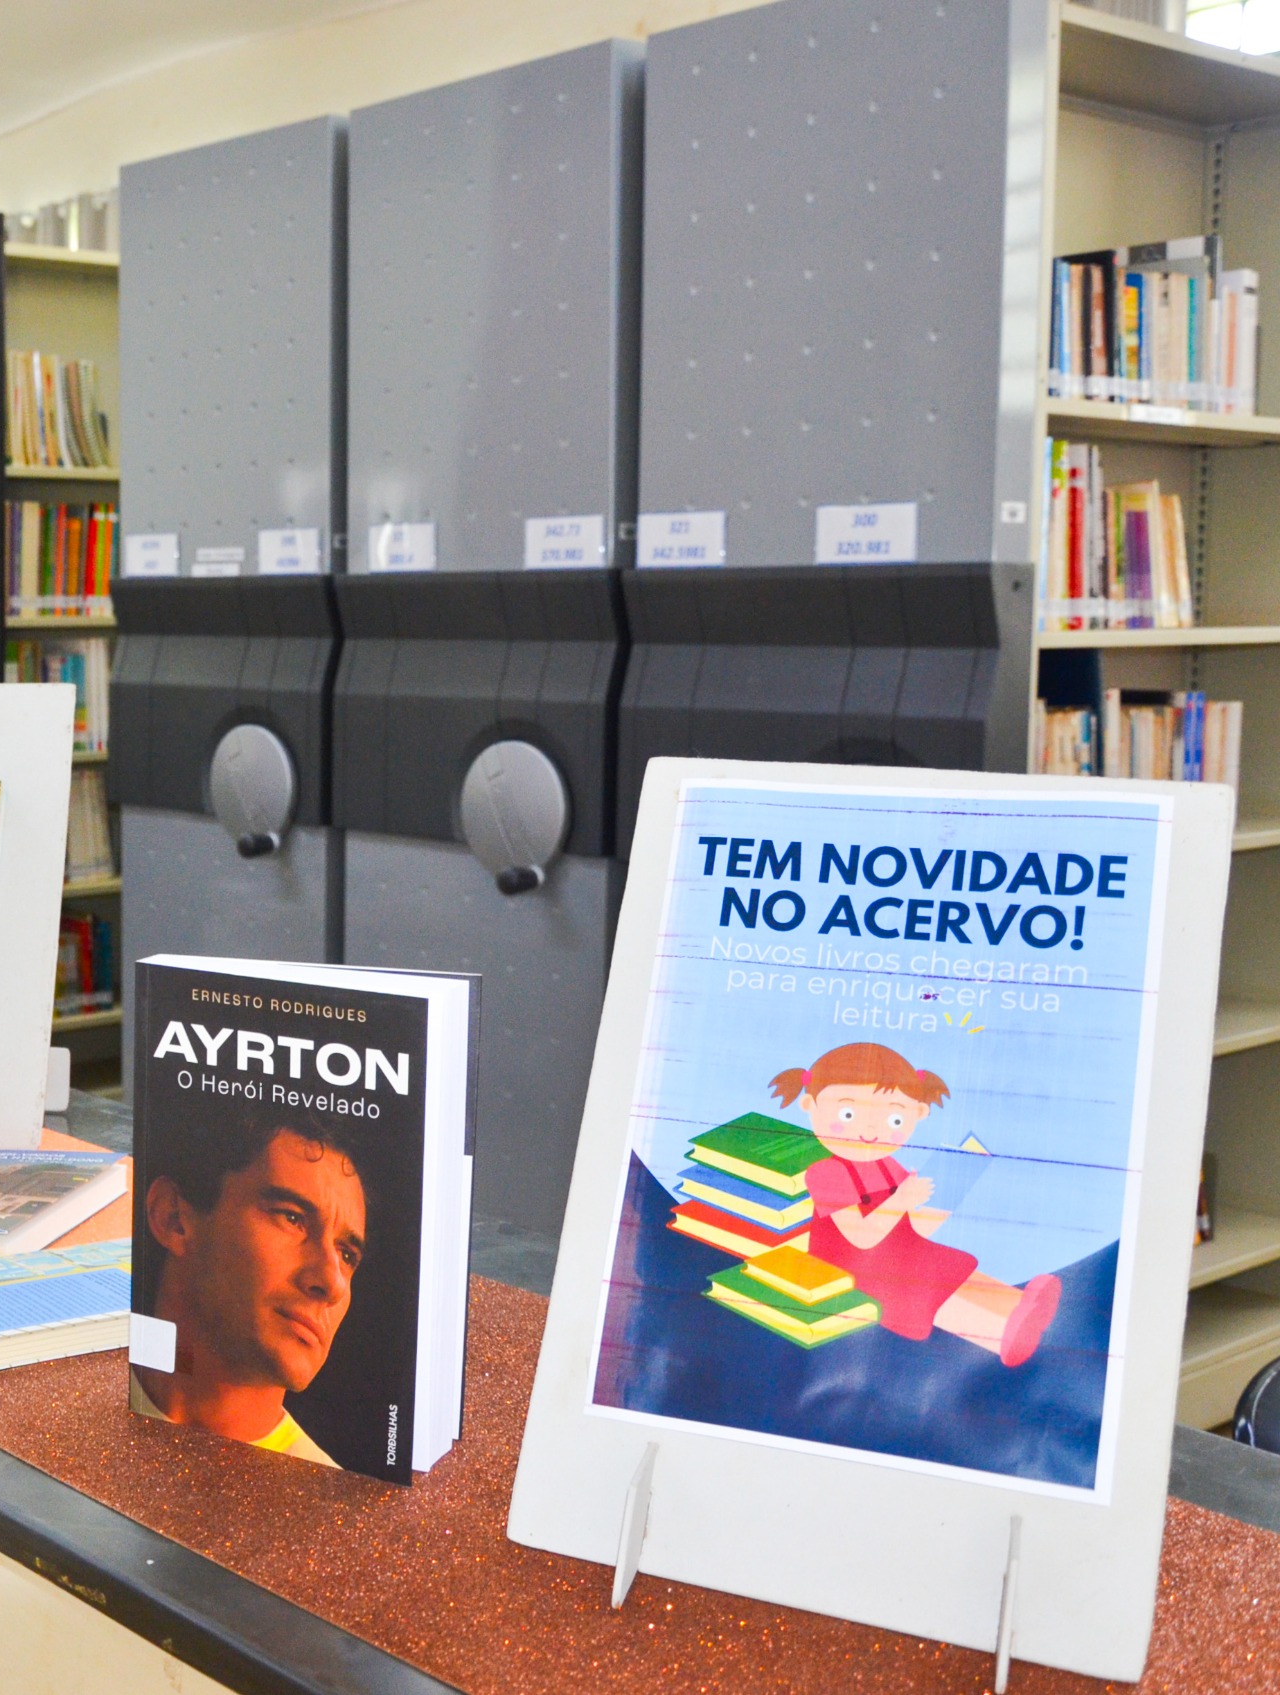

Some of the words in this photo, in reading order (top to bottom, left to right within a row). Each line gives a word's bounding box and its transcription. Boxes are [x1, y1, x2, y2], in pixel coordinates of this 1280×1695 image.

[698, 836, 802, 882] TEM
[818, 842, 1128, 899] NOVIDADE
[719, 886, 806, 932] NO
[817, 894, 1086, 951] ACERVO!
[710, 936, 807, 966] Novos
[817, 942, 900, 972] livros
[910, 949, 1089, 991] chegaram
[191, 989, 263, 1009] ERNESTO
[270, 999, 367, 1023] RODRIGUES
[726, 968, 796, 995] para
[807, 974, 991, 1008] enriquecer
[1000, 989, 1061, 1013] sua
[833, 1001, 938, 1033] leitura
[153, 1020, 410, 1096] AYRTON
[177, 1070, 192, 1089] O
[201, 1074, 264, 1101] Herói
[272, 1084, 381, 1120] Revelado
